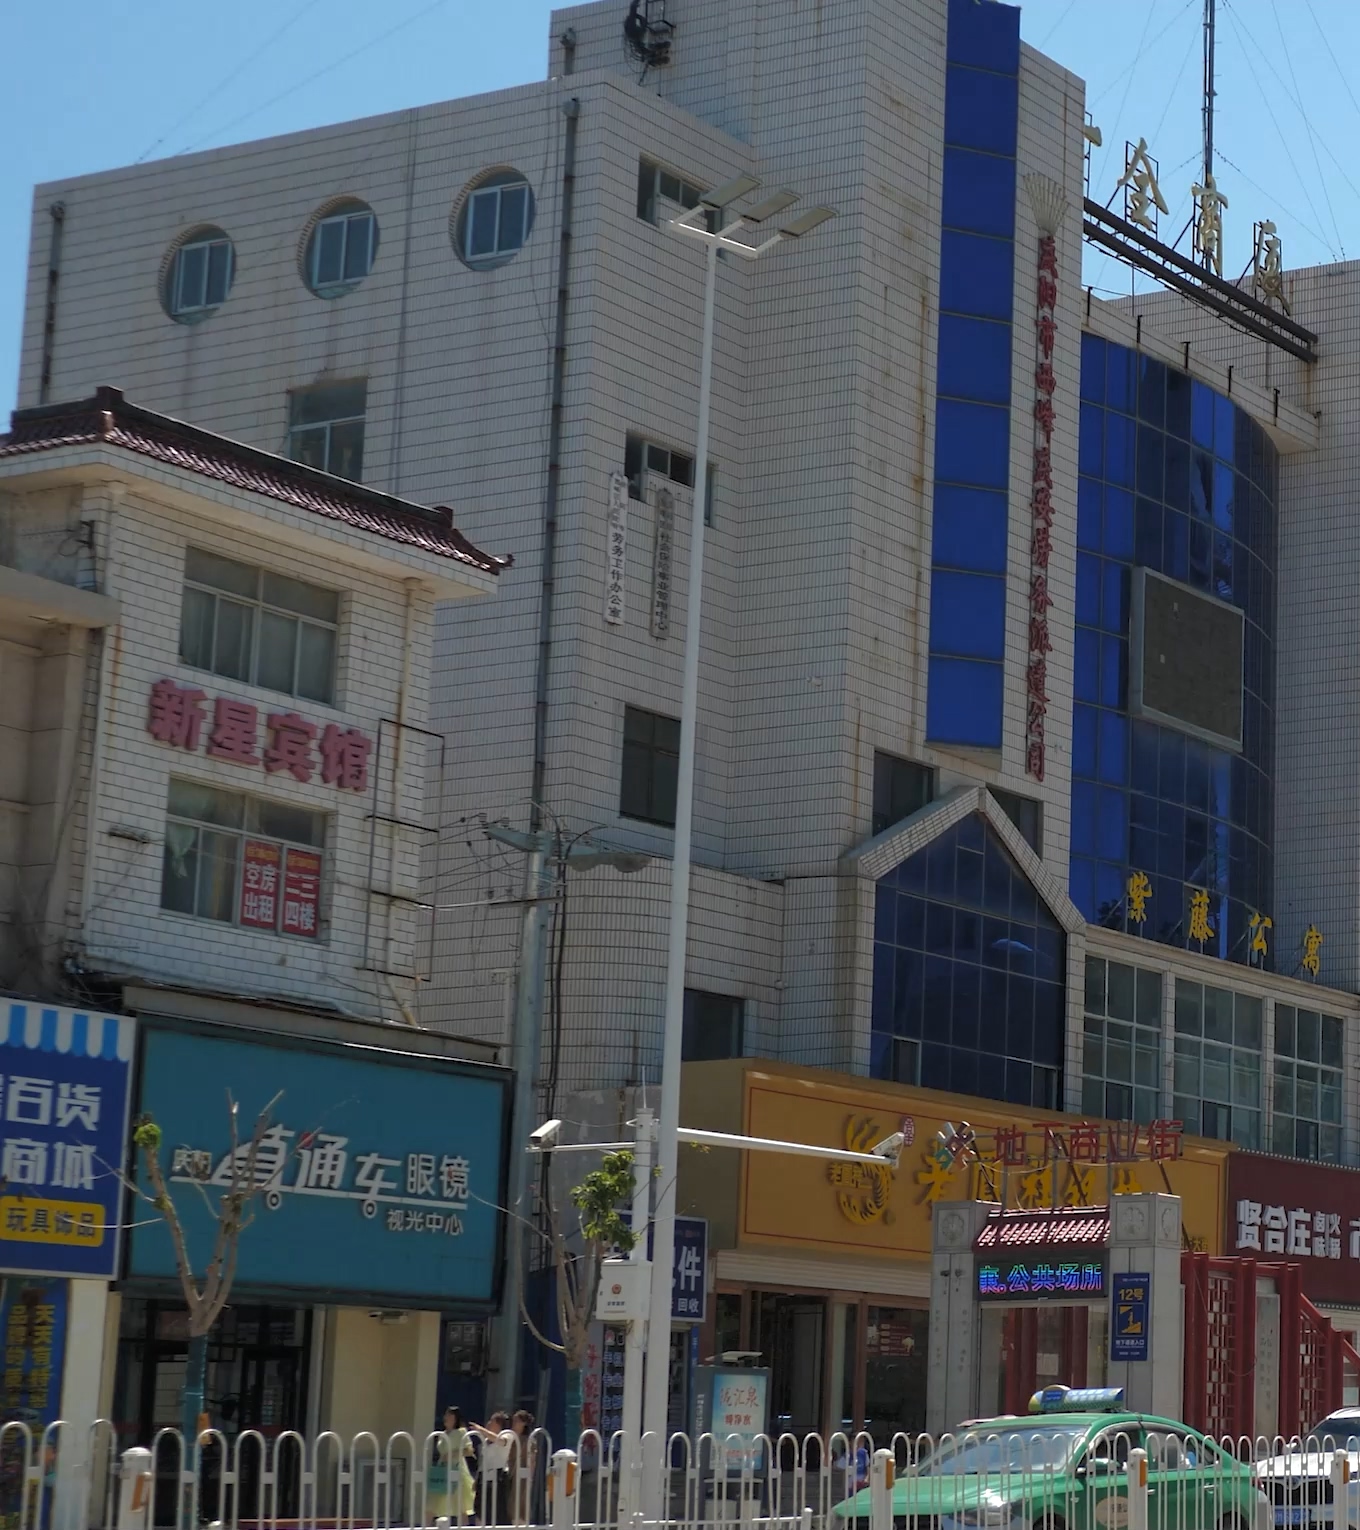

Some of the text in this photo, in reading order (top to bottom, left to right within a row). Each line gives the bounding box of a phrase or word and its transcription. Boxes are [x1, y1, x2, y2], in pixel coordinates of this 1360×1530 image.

[148, 678, 374, 792] 新星宾馆
[245, 860, 277, 893] 空房
[243, 892, 275, 923] 出租
[284, 900, 316, 931] 四楼
[1127, 870, 1324, 977] 紫藤公寓
[0, 1072, 102, 1132] 百货
[1, 1136, 98, 1191] 商城
[993, 1119, 1184, 1168] 地下商业街
[4, 1206, 97, 1239] 玩具饰品
[386, 1208, 464, 1237] 视光中心
[1235, 1198, 1312, 1257] 贤合庄
[1118, 1288, 1144, 1301] 12号
